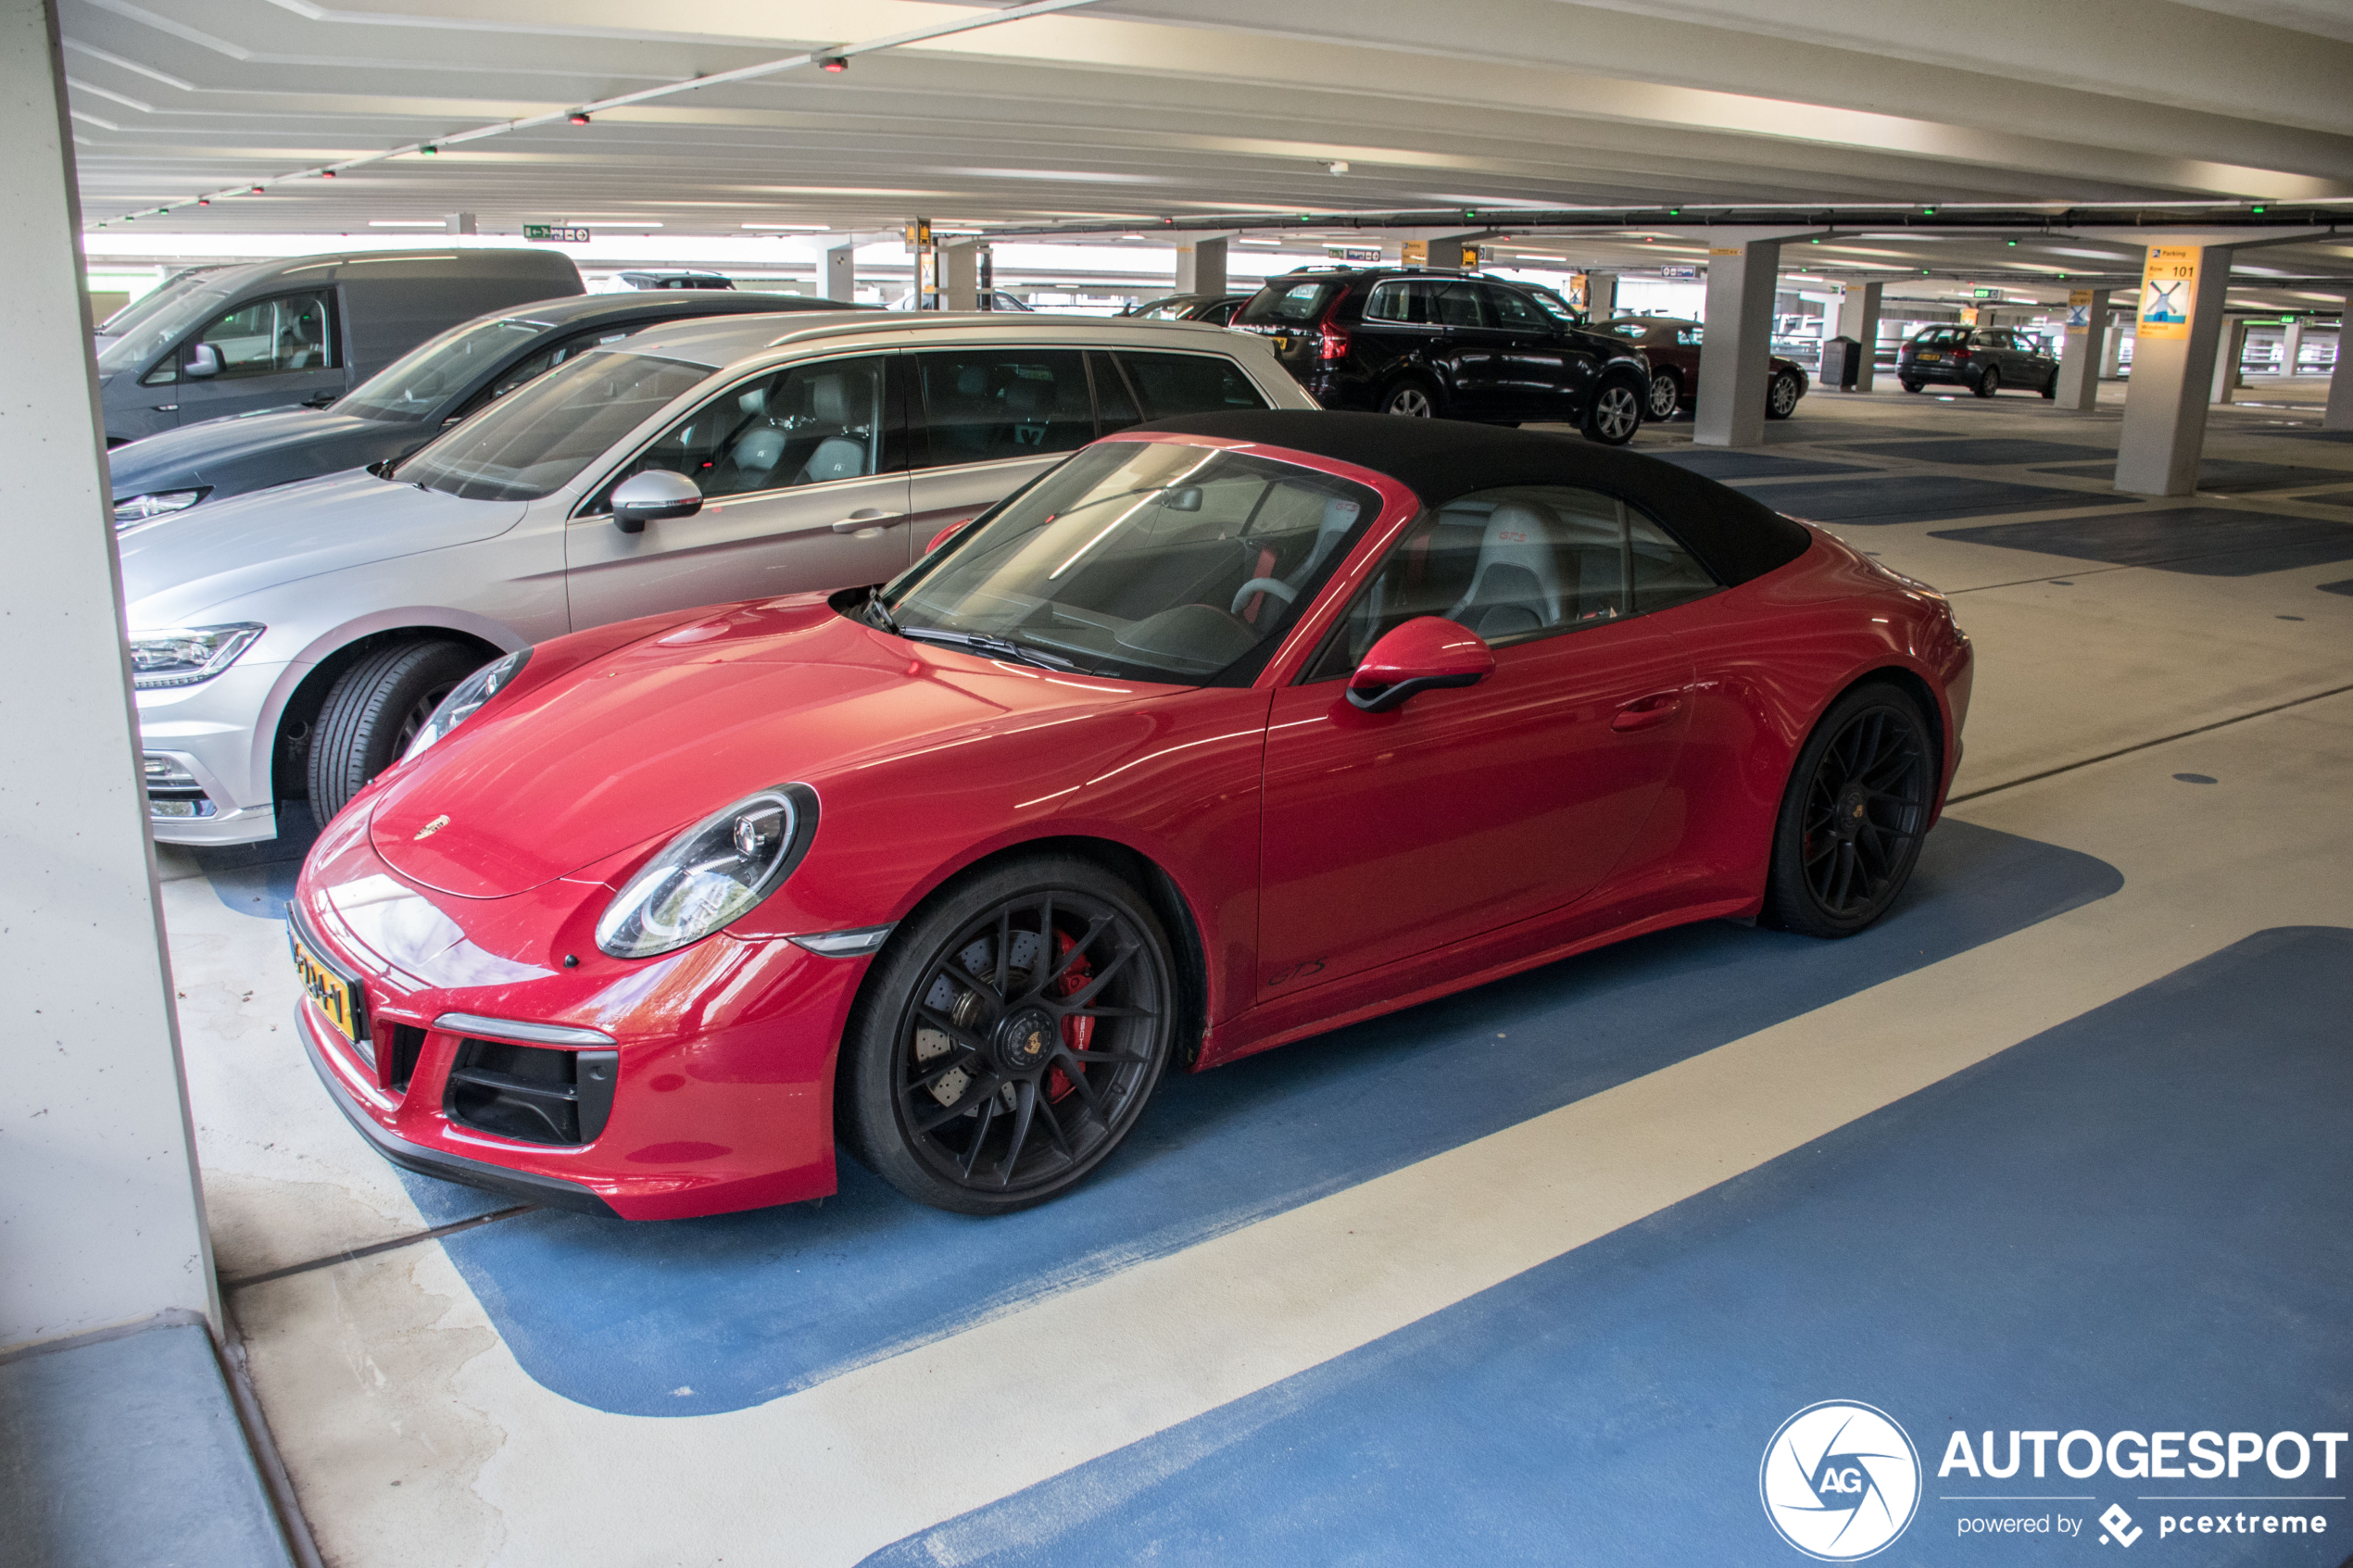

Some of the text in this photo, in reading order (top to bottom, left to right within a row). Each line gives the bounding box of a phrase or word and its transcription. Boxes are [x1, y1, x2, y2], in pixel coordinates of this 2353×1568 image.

[2173, 267, 2194, 277] 101
[1500, 532, 1526, 542] GTS
[1268, 956, 1328, 985] GTS
